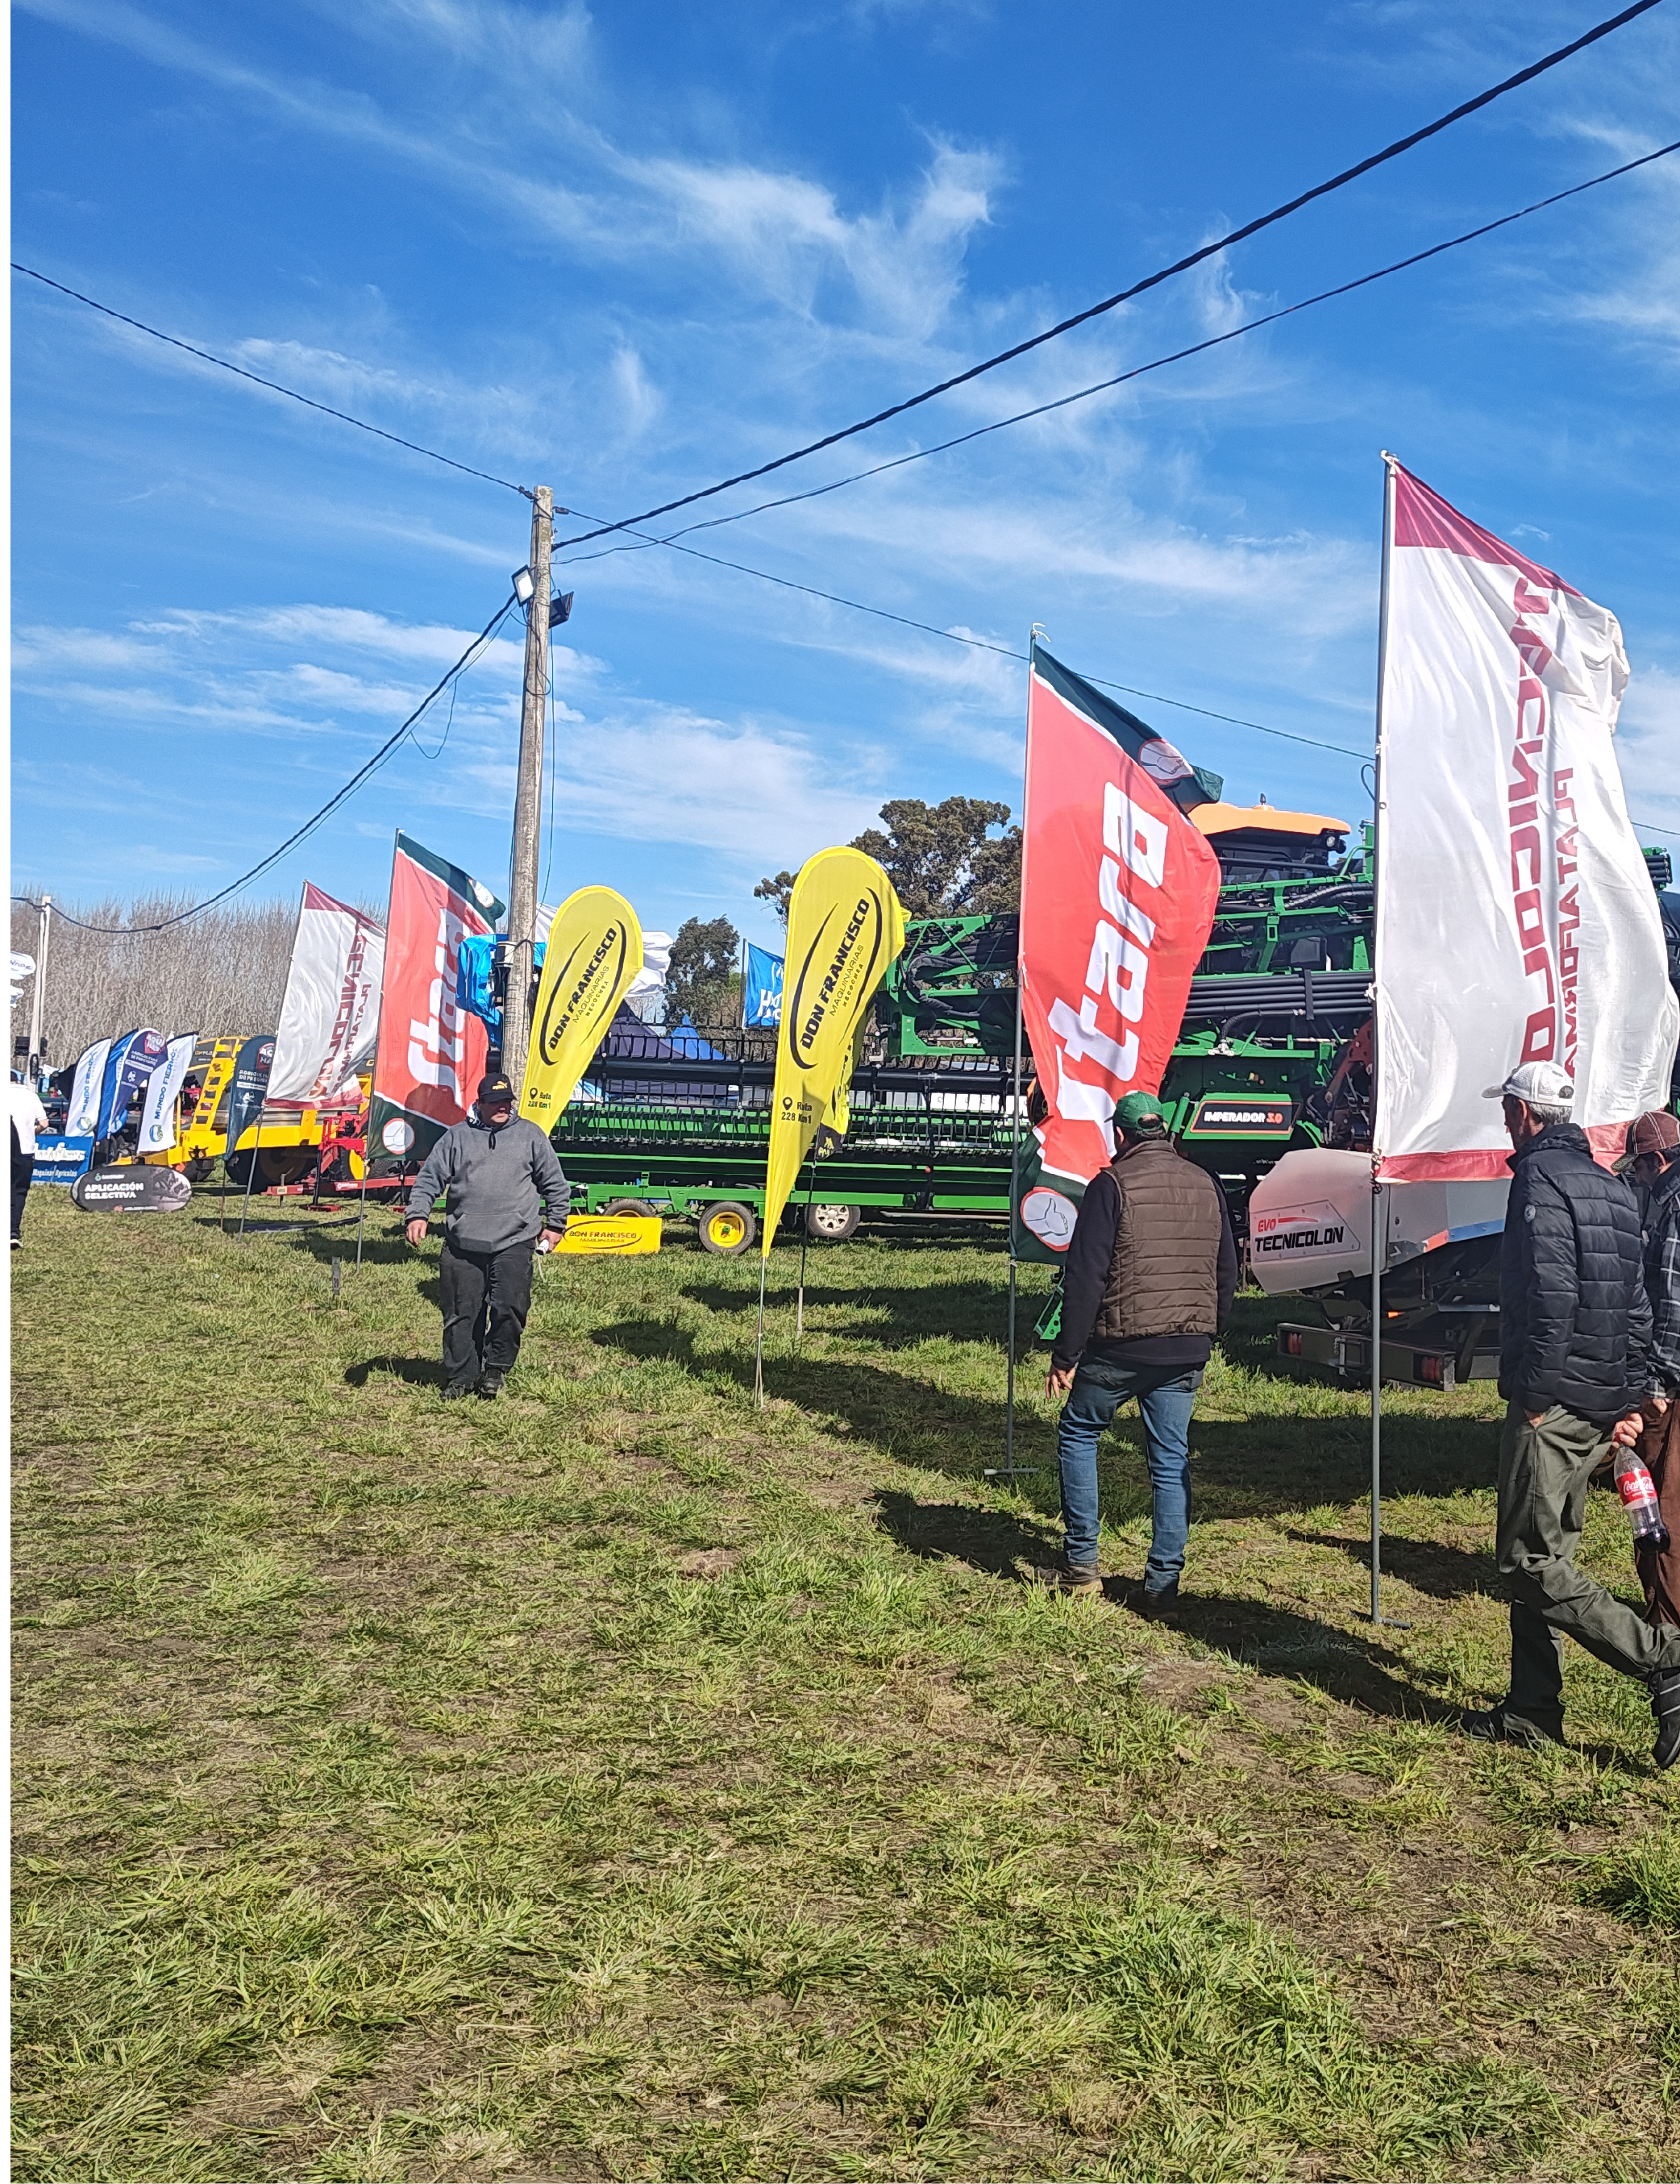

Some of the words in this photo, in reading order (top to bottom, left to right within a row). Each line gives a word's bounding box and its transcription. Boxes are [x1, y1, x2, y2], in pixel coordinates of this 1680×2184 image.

[800, 1003, 825, 1050] DON
[818, 898, 870, 1004] FRANCISCO
[829, 944, 864, 1016] MAQUINARIAS
[548, 1013, 571, 1050] DON
[568, 927, 618, 1013] FRANCISCO
[572, 965, 610, 1023] MAQUINARIAS
[154, 1087, 166, 1119] MUNDO
[796, 1101, 813, 1111] Ruta
[781, 1112, 796, 1121] 228
[1204, 1112, 1266, 1122] IMPERADOR
[84, 1181, 144, 1192] APLICACIÓN
[84, 1192, 137, 1200] SELECTIVA
[1258, 1218, 1276, 1233] EVO
[589, 1231, 637, 1239] FRANCISCO
[1254, 1226, 1345, 1252] TECNICOLON
